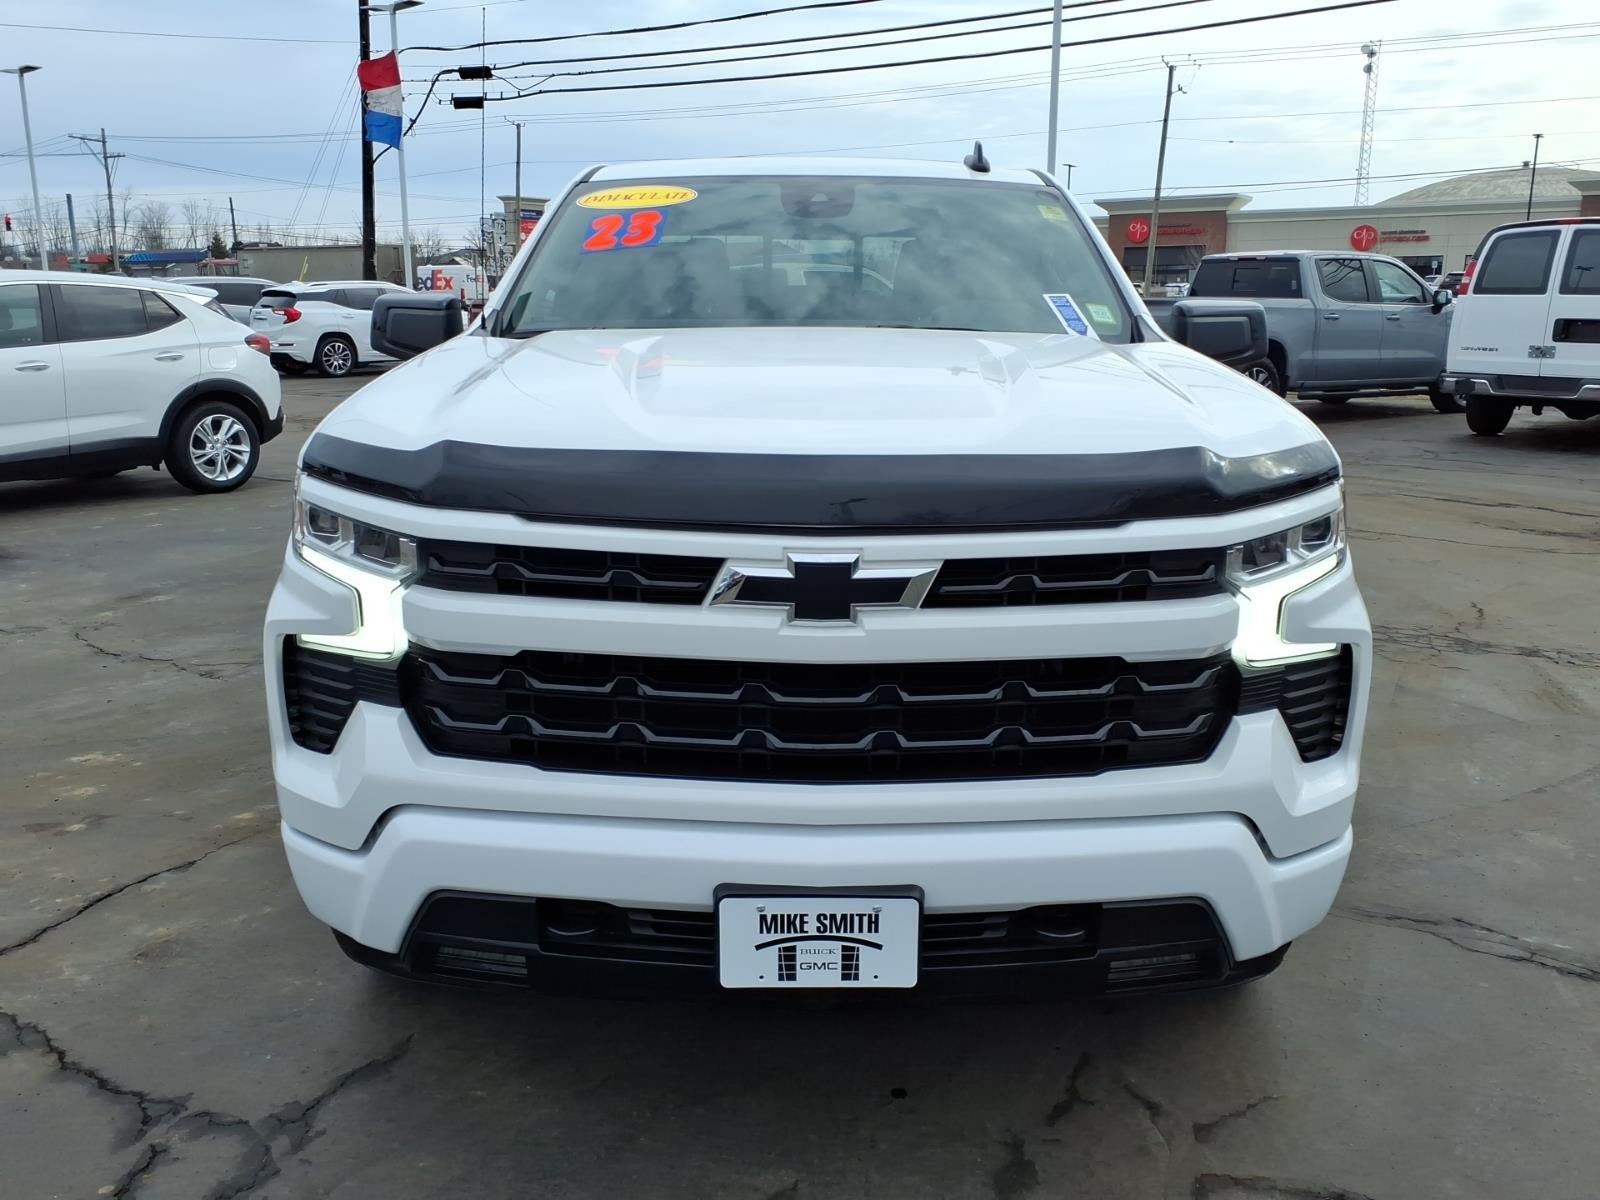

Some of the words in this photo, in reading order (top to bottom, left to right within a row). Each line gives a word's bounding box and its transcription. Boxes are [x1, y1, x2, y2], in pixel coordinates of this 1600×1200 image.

[583, 210, 662, 251] 23
[414, 269, 454, 291] edEx
[759, 913, 809, 934] MIKE
[815, 913, 880, 934] SMITH
[799, 962, 838, 970] GMC
